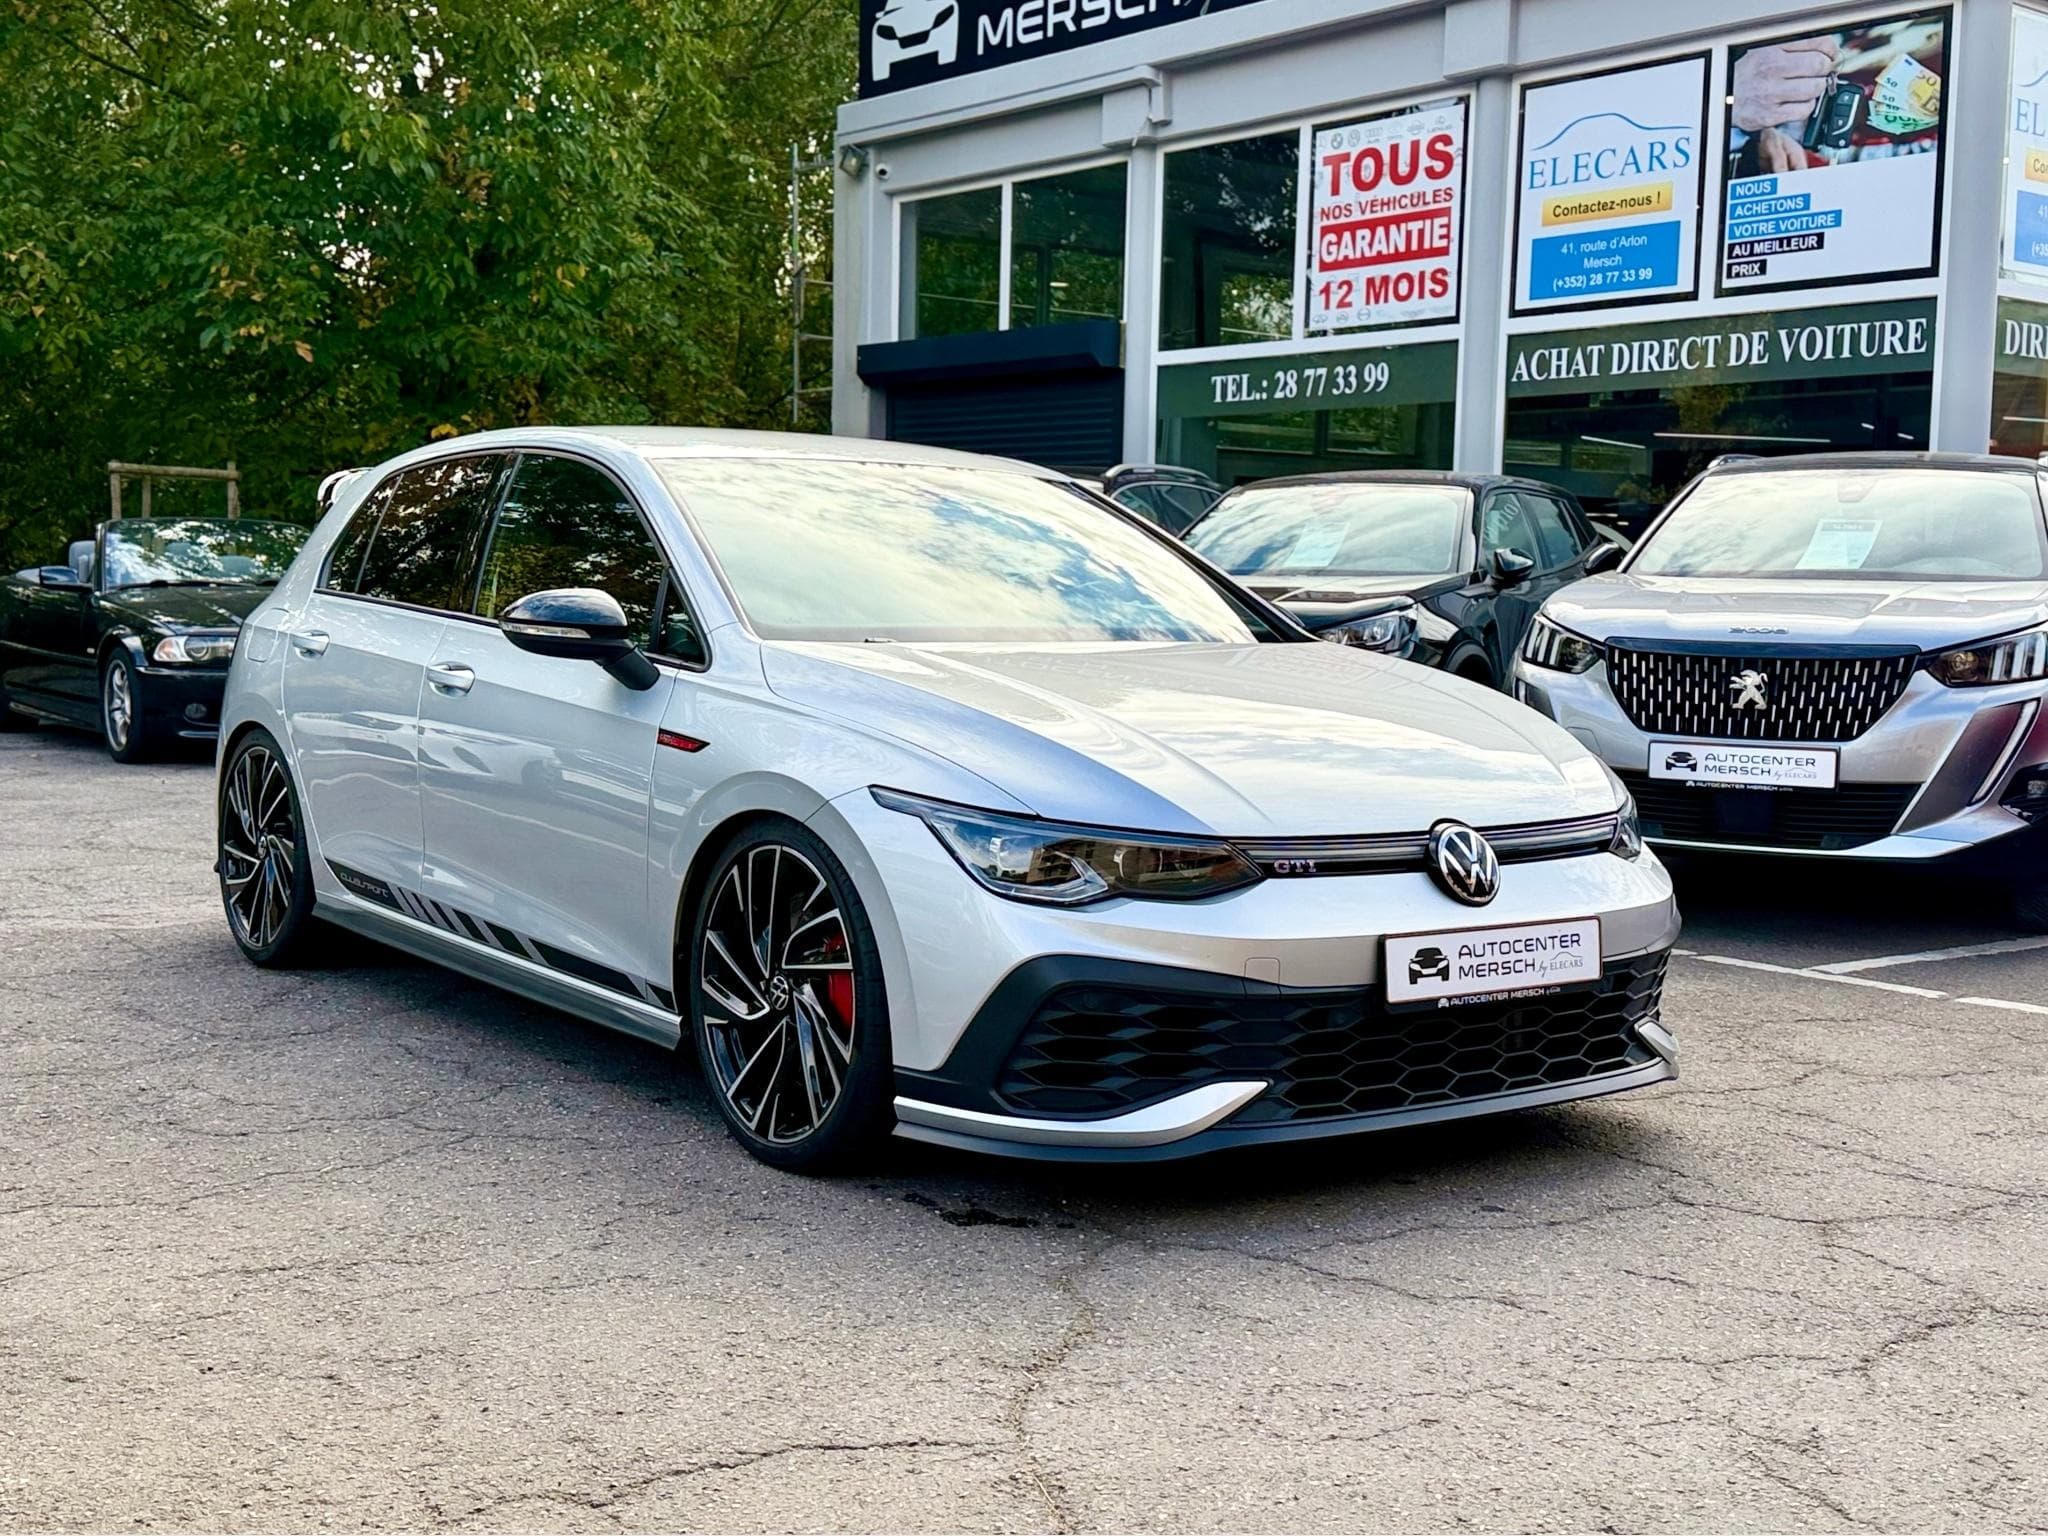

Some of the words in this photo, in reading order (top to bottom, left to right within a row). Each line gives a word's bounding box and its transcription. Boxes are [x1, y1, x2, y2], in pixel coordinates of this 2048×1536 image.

[977, 0, 1182, 55] MERSC
[1323, 134, 1454, 197] TOUS
[1528, 136, 1691, 190] ELECARS
[1736, 181, 1771, 196] NOUS
[1320, 203, 1353, 220] NOS
[1359, 187, 1454, 215] VÉHICULES
[1553, 194, 1652, 218] Contactez-nous
[1656, 191, 1661, 204] !
[1735, 197, 1804, 217] ACHETONS
[1734, 221, 1776, 237] VOTRE
[1779, 213, 1836, 231] VOITURE
[1321, 216, 1449, 263] GARANTIE
[1561, 243, 1578, 256] 41,
[1580, 240, 1607, 253] route
[1732, 243, 1750, 257] AU
[1753, 235, 1818, 254] MEILLEUR
[1583, 255, 1622, 269] Mersch
[1731, 262, 1760, 277] PRIX
[1319, 280, 1353, 310] 12
[1365, 267, 1449, 306] MOIS
[1553, 275, 1587, 292] (+352)
[1590, 274, 1602, 287] 28
[1606, 272, 1619, 284] 77
[1622, 270, 1635, 282] 33
[1639, 268, 1652, 280] 99
[1511, 344, 1604, 382] ACHAT
[1609, 334, 1721, 375] DIRECT
[1726, 330, 1769, 367] DE
[1777, 317, 1928, 362] VOITURE
[1211, 373, 1267, 403] TEL.:
[1273, 369, 1298, 398] 28
[1303, 367, 1328, 397] 77
[1331, 364, 1358, 395] 33
[1363, 362, 1389, 393] 99
[1704, 765, 1771, 776] MERSCH
[1705, 753, 1816, 767] AUTOCENTER
[1273, 859, 1316, 873] GTI
[1459, 933, 1581, 959] AUTOCENTER
[1459, 959, 1536, 980] MERSCH
[1550, 959, 1583, 971] ELECARS
[1451, 991, 1509, 1005] AUTOCENTER
[1511, 988, 1544, 999] MERSCH
